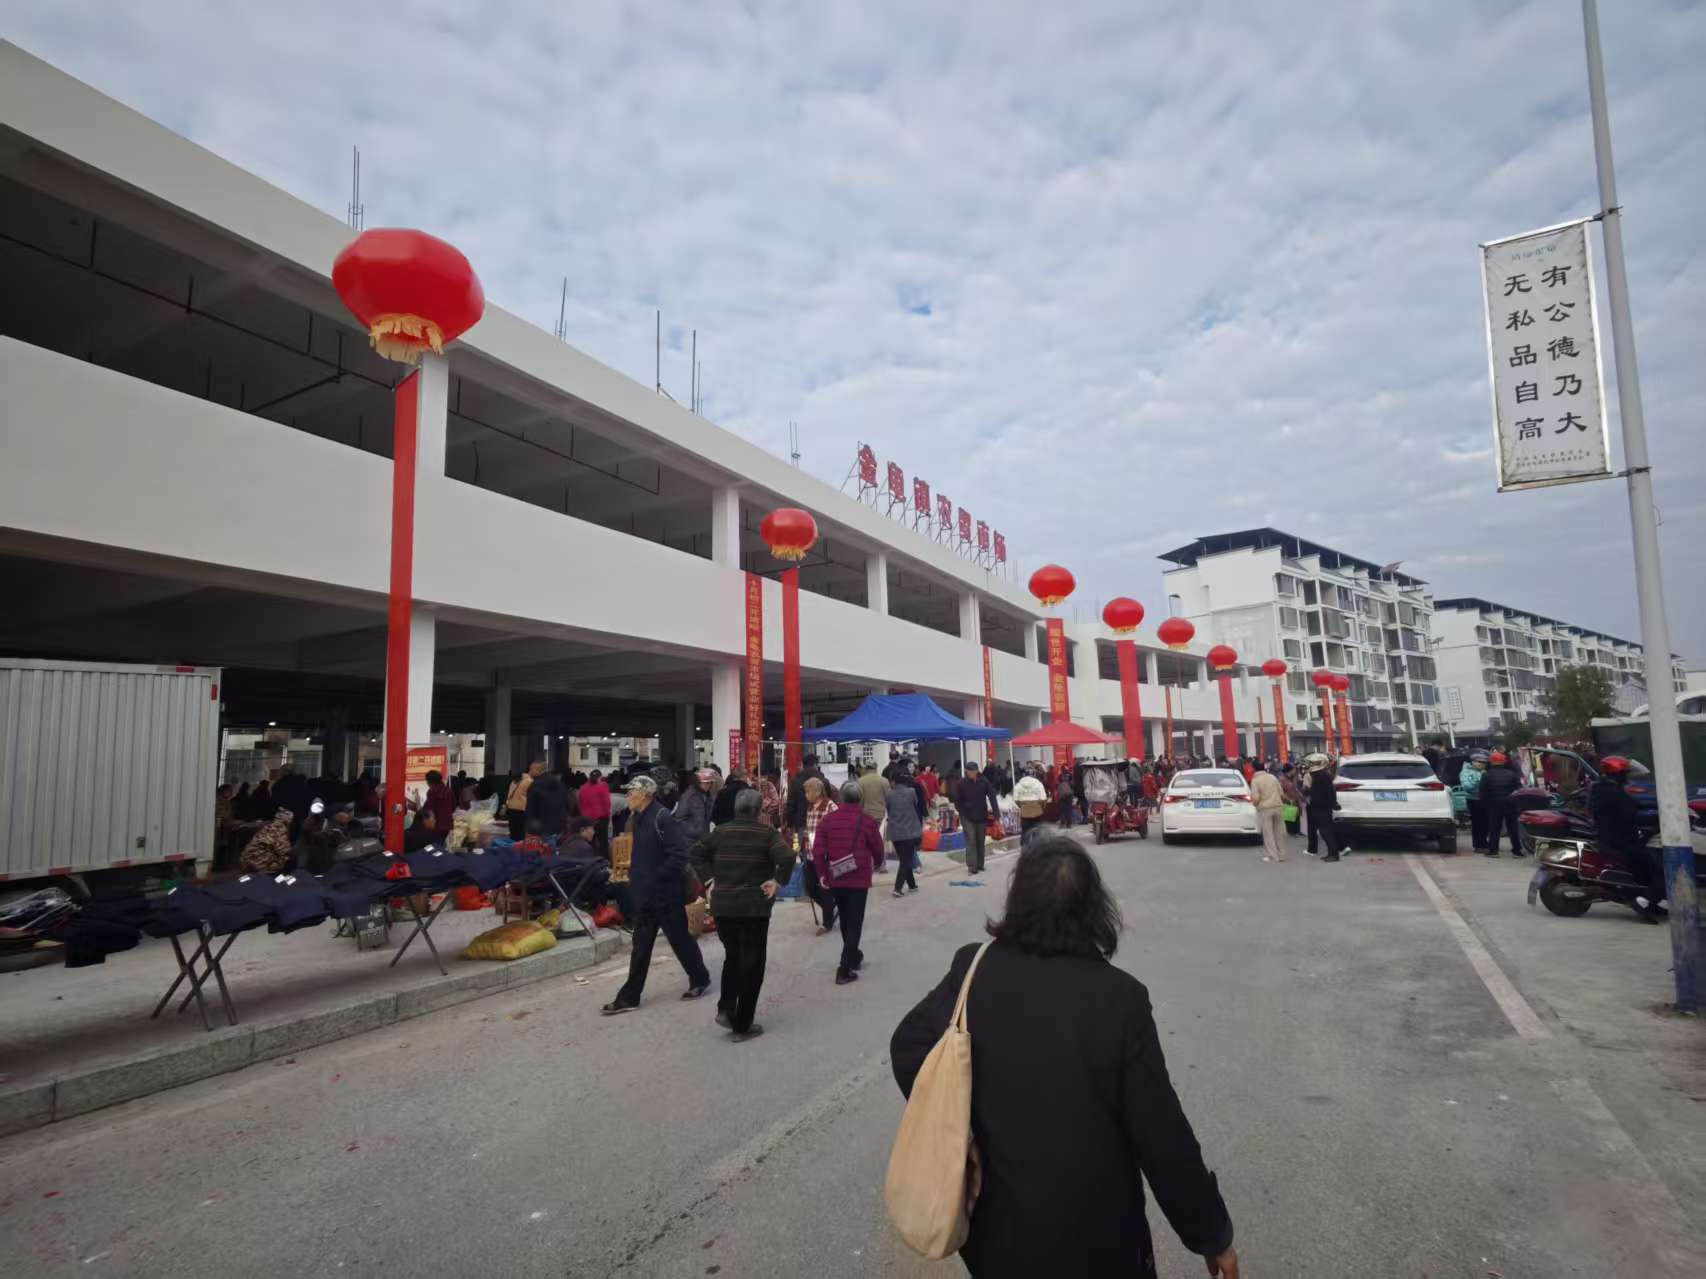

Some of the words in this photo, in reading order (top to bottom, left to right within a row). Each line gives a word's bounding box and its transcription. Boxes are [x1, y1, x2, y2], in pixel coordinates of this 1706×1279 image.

[1503, 274, 1544, 441] 无私品自高
[1541, 265, 1587, 434] 有公德乃大
